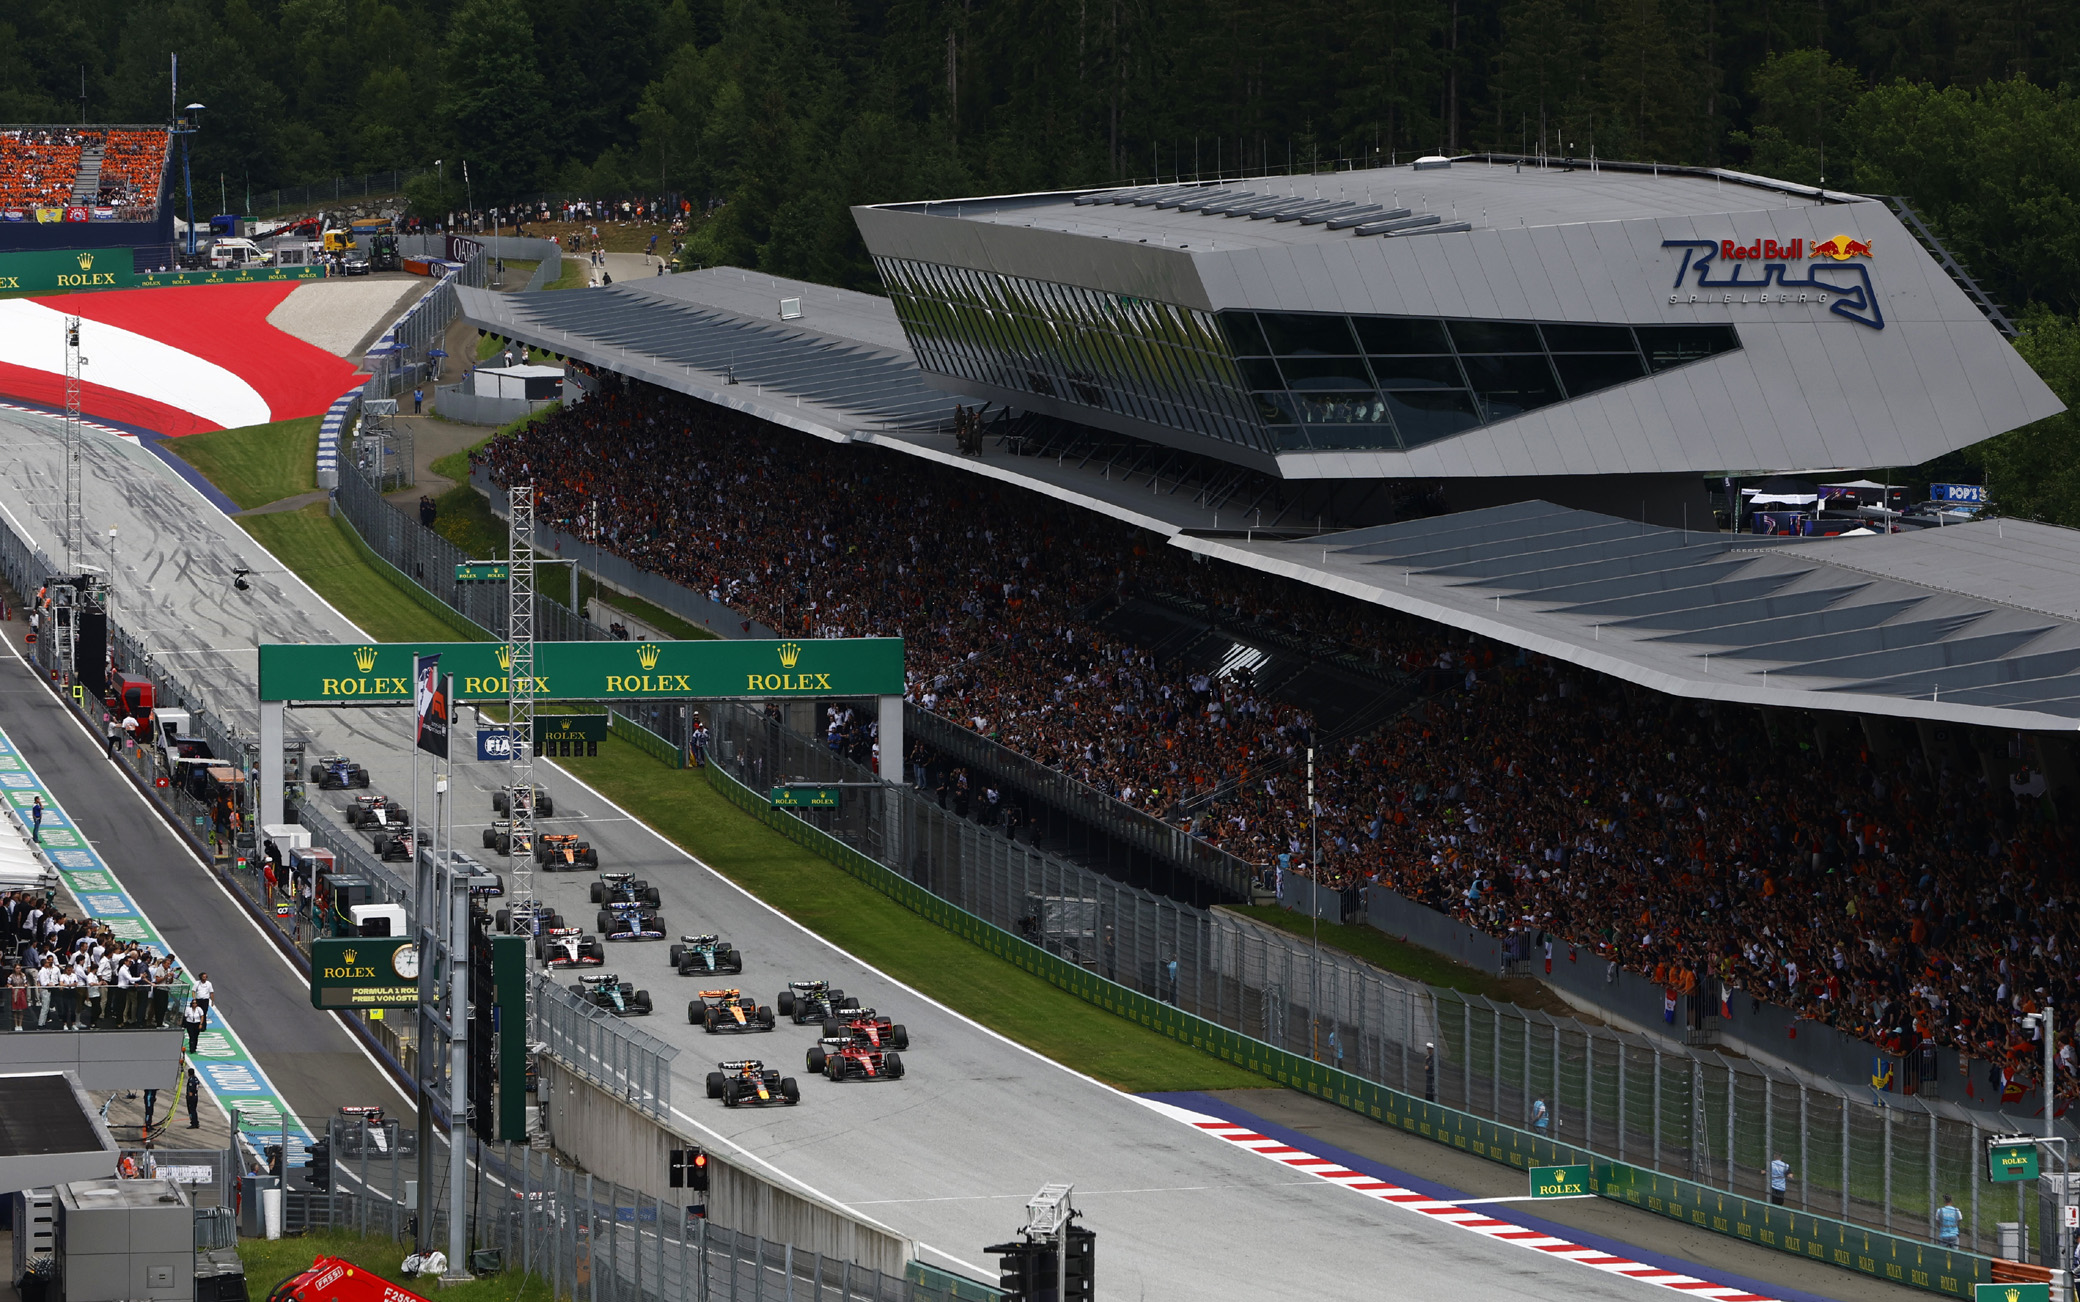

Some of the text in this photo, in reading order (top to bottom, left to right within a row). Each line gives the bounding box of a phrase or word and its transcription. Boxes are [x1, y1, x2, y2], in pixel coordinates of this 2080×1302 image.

[1721, 238, 1803, 259] Red Bull
[57, 273, 116, 286] ROLEX
[1661, 240, 1884, 330] Ring
[1669, 293, 1828, 304] SPIELBERG
[1949, 486, 1978, 500] POP'S
[322, 678, 409, 695] ROLEX
[464, 676, 551, 694] ROLEX
[606, 675, 692, 692] ROLEX
[747, 673, 832, 691] ROLEX
[545, 731, 586, 740] ROLEX
[324, 967, 376, 979] ROLEX
[1540, 1184, 1582, 1195] ROLEX
[316, 1266, 343, 1289] FASSI
